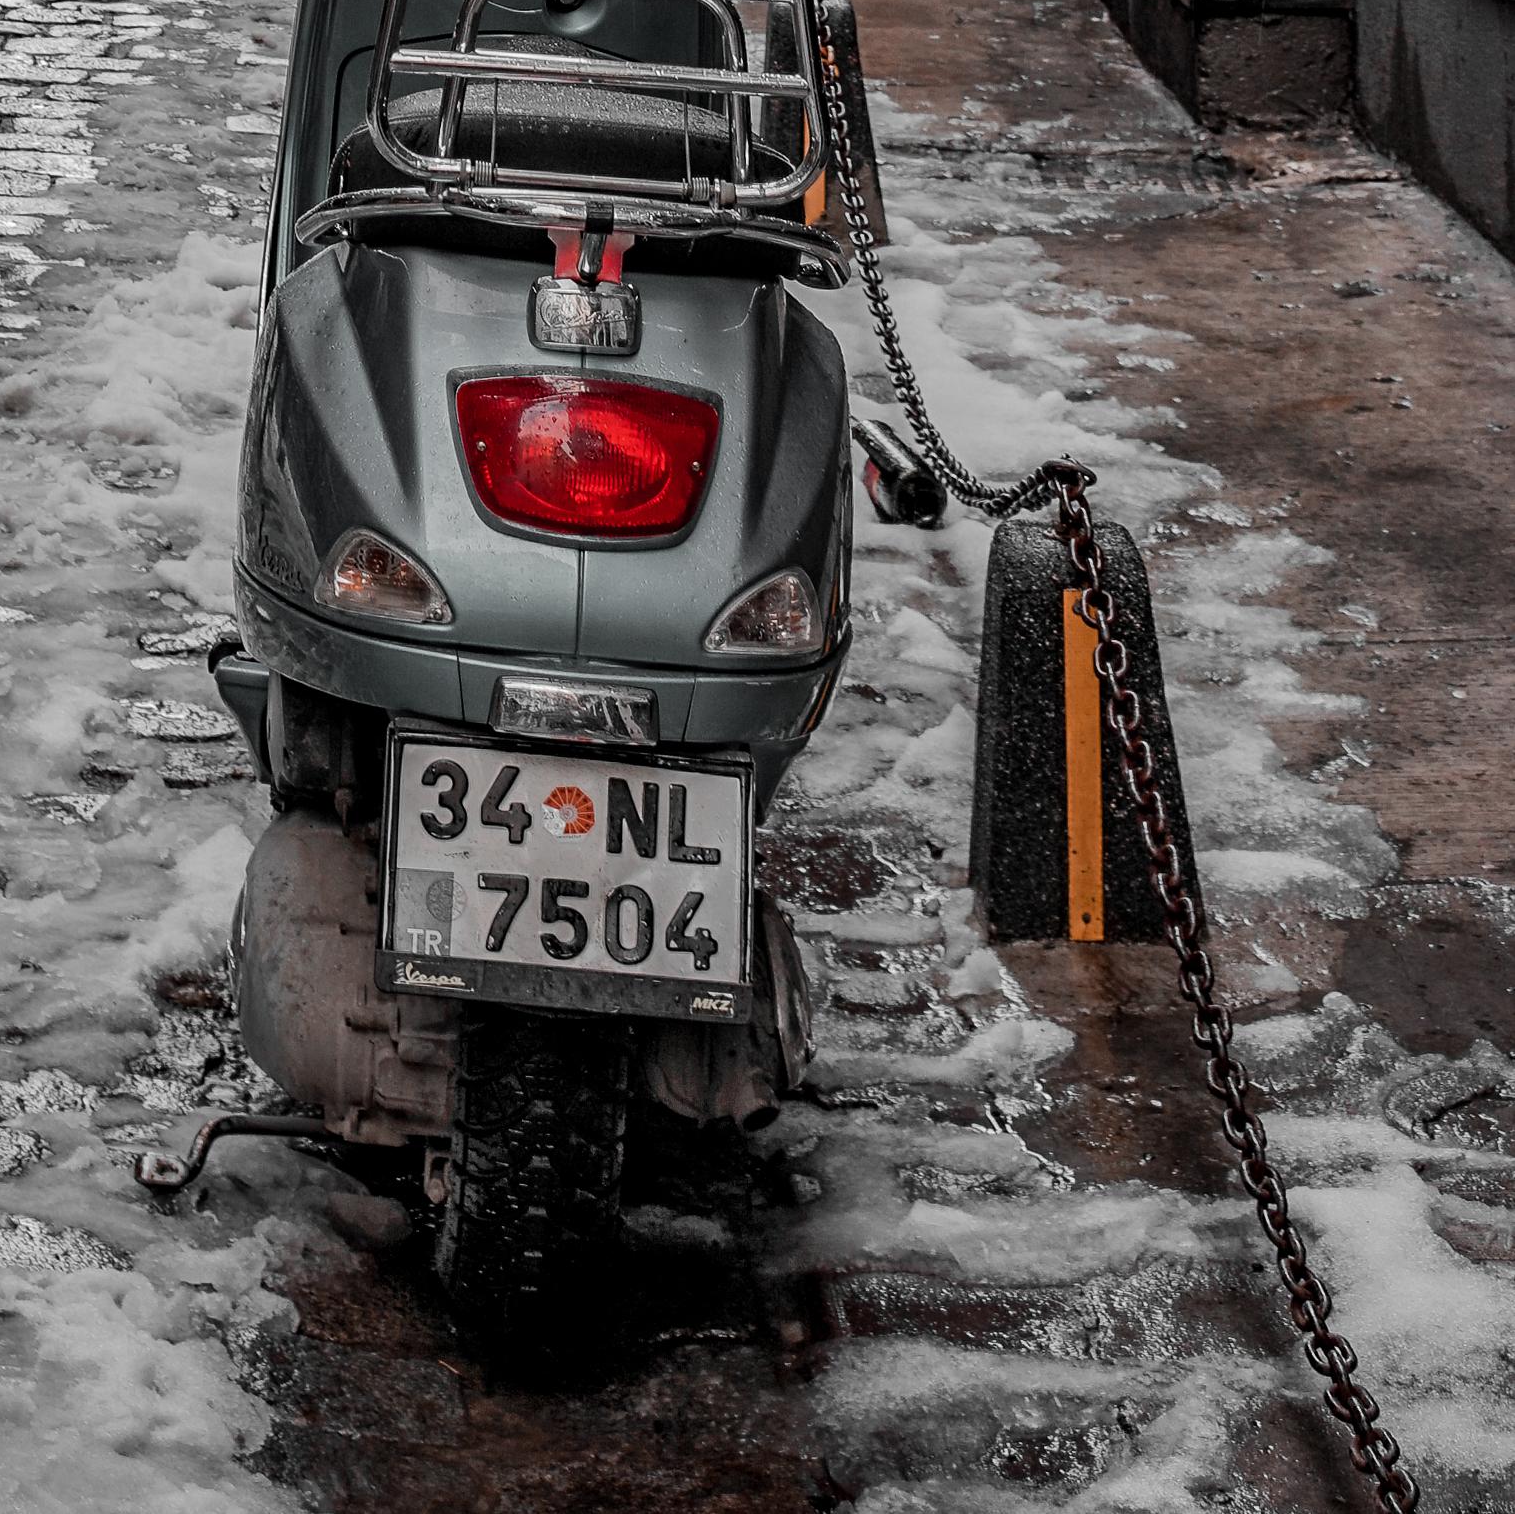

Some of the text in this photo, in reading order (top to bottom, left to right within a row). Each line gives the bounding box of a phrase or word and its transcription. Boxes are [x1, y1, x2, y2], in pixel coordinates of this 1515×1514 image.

[419, 758, 721, 866] 34 NL
[406, 927, 443, 956] TR
[477, 872, 719, 971] 7504
